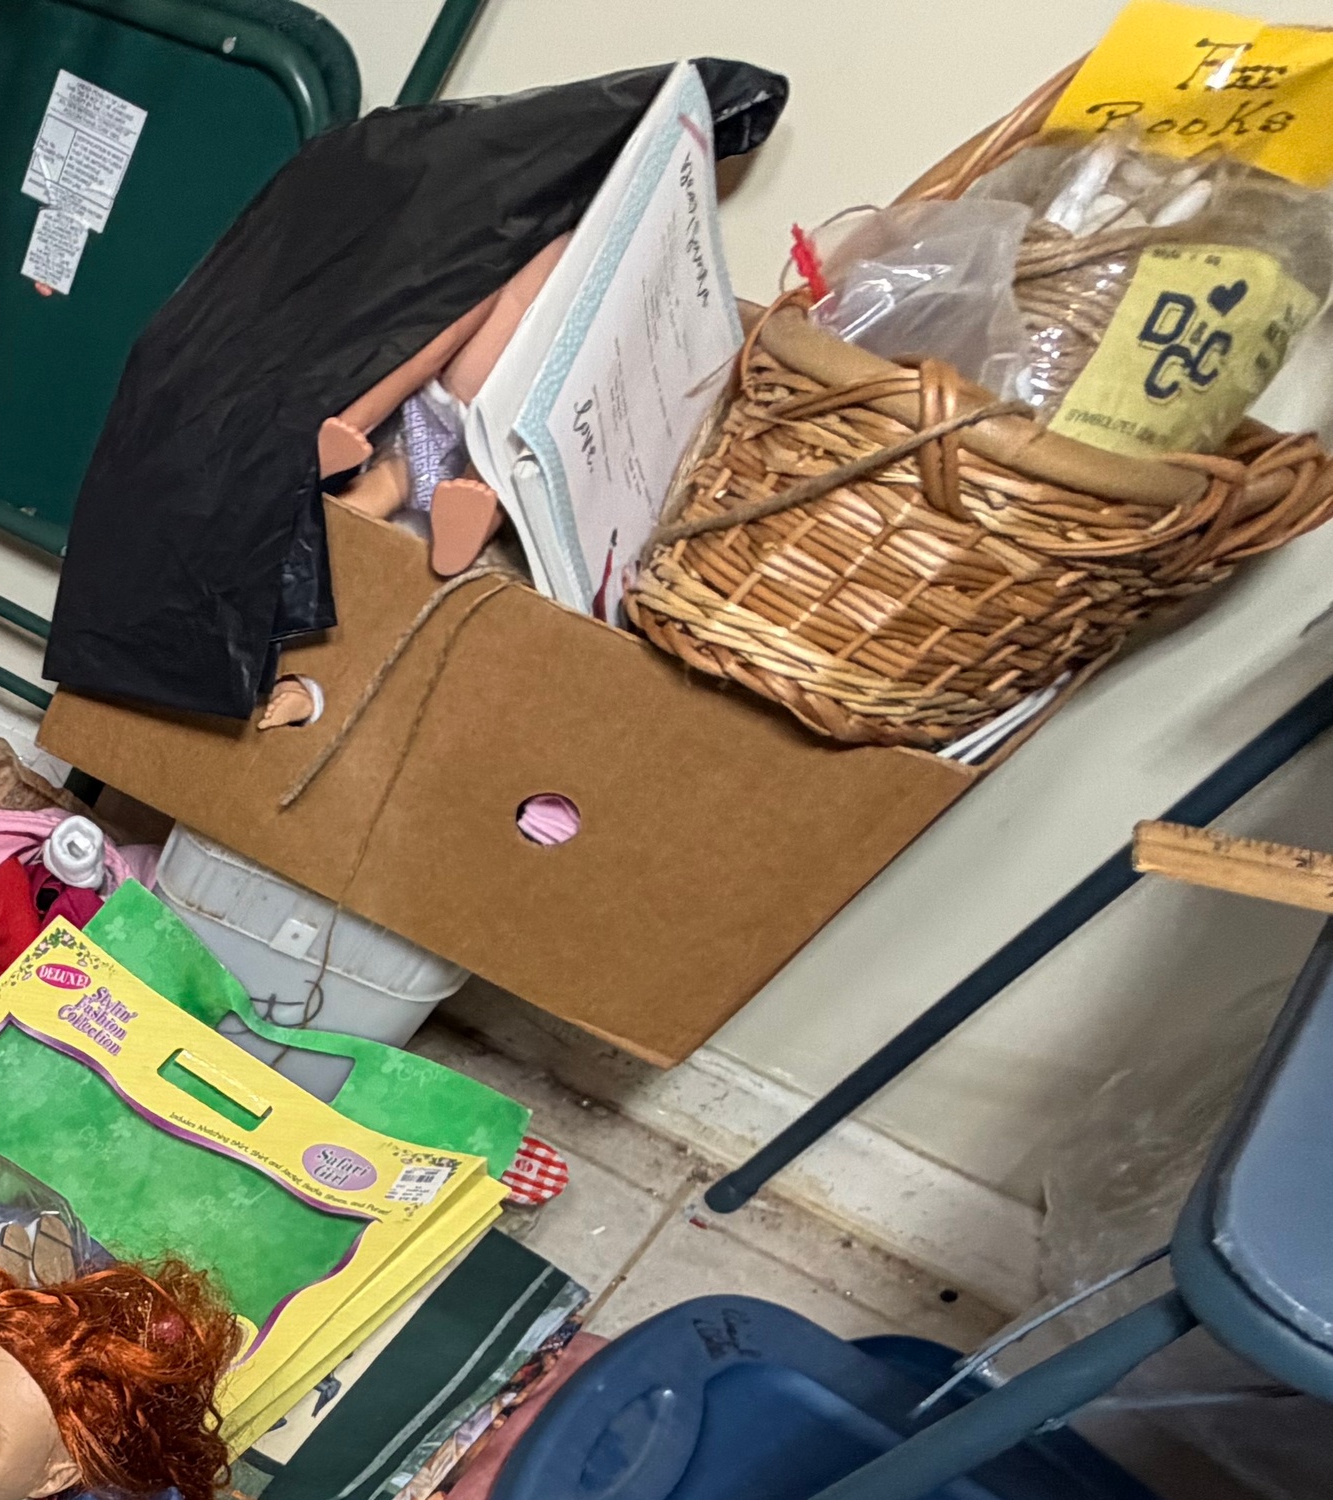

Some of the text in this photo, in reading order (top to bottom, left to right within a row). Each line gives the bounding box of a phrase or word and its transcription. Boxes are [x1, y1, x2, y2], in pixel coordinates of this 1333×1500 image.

[39, 966, 89, 988] DELUXE!
[58, 1004, 122, 1056] Collection
[75, 994, 127, 1041] Fashion
[313, 1164, 349, 1187] Girl
[317, 1148, 371, 1177] Safari
